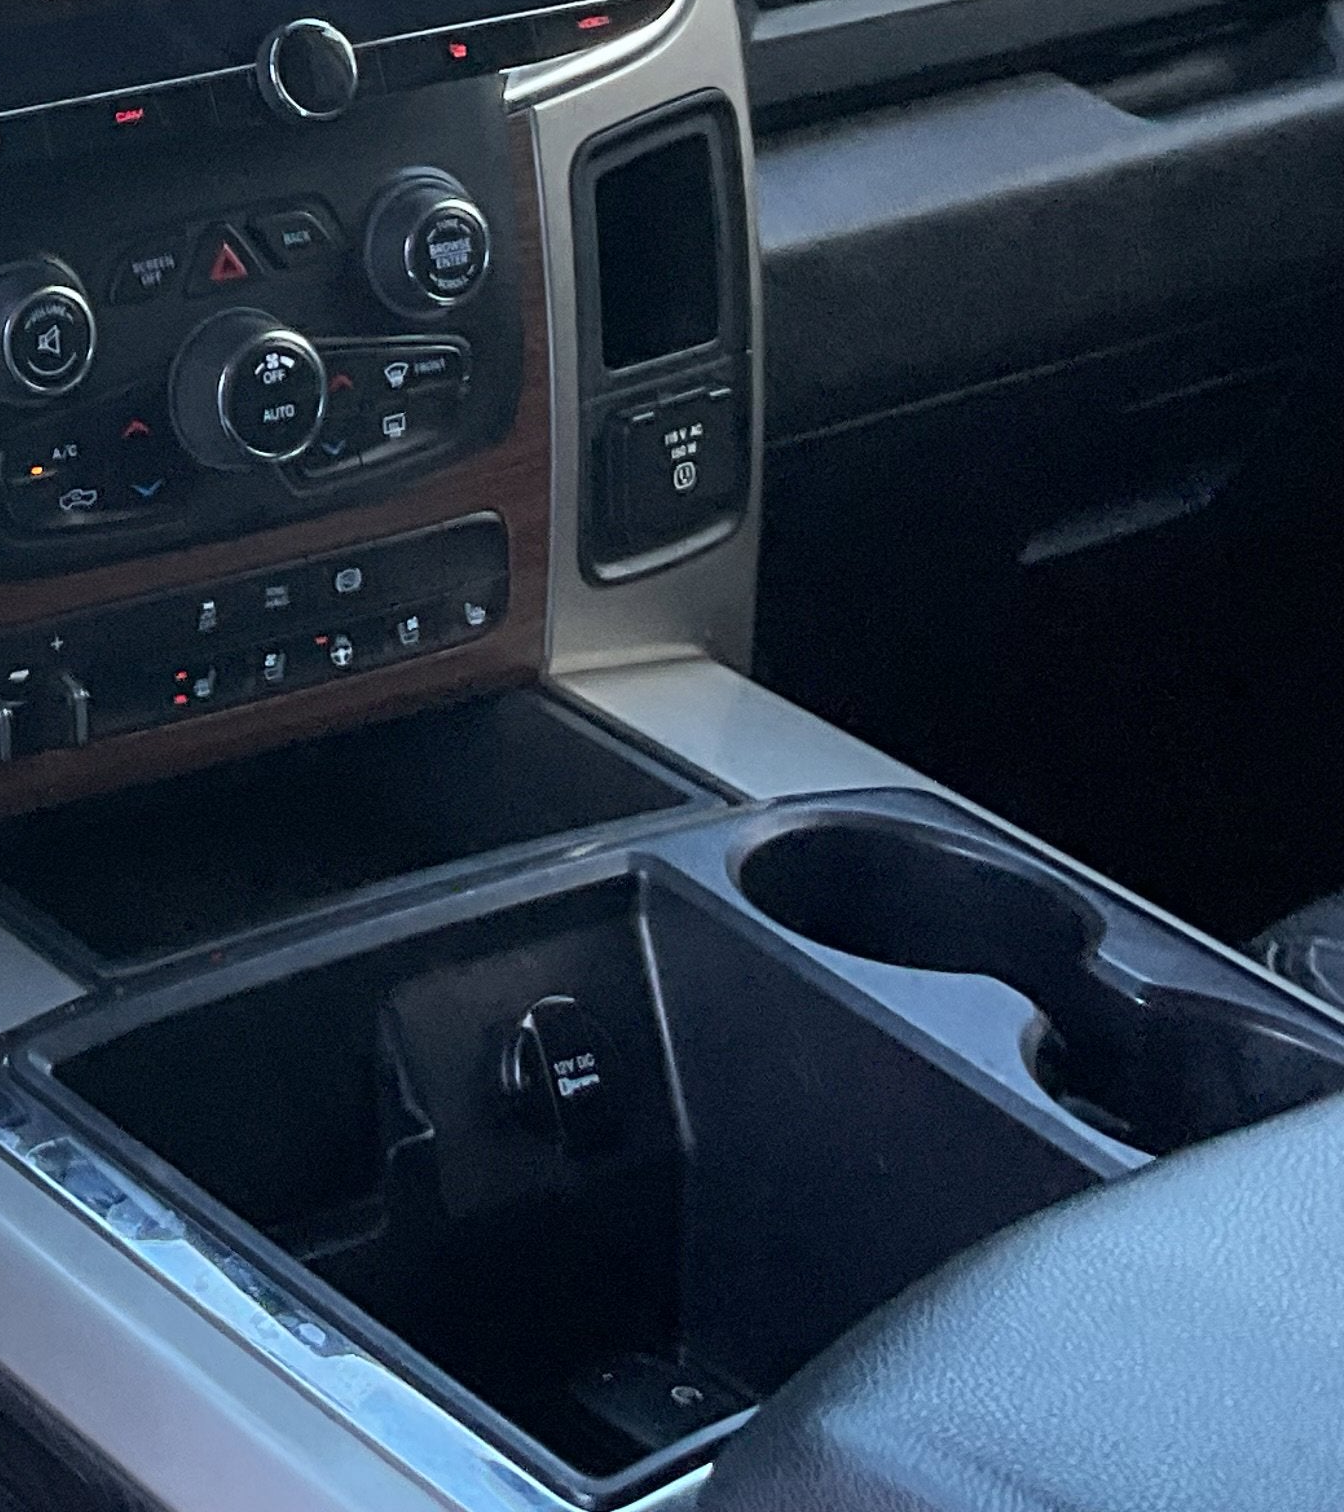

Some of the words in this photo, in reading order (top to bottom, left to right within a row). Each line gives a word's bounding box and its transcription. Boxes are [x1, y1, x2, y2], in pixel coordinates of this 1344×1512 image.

[263, 370, 286, 384] OFF
[263, 404, 295, 423] AUTO
[52, 444, 78, 459] A/C
